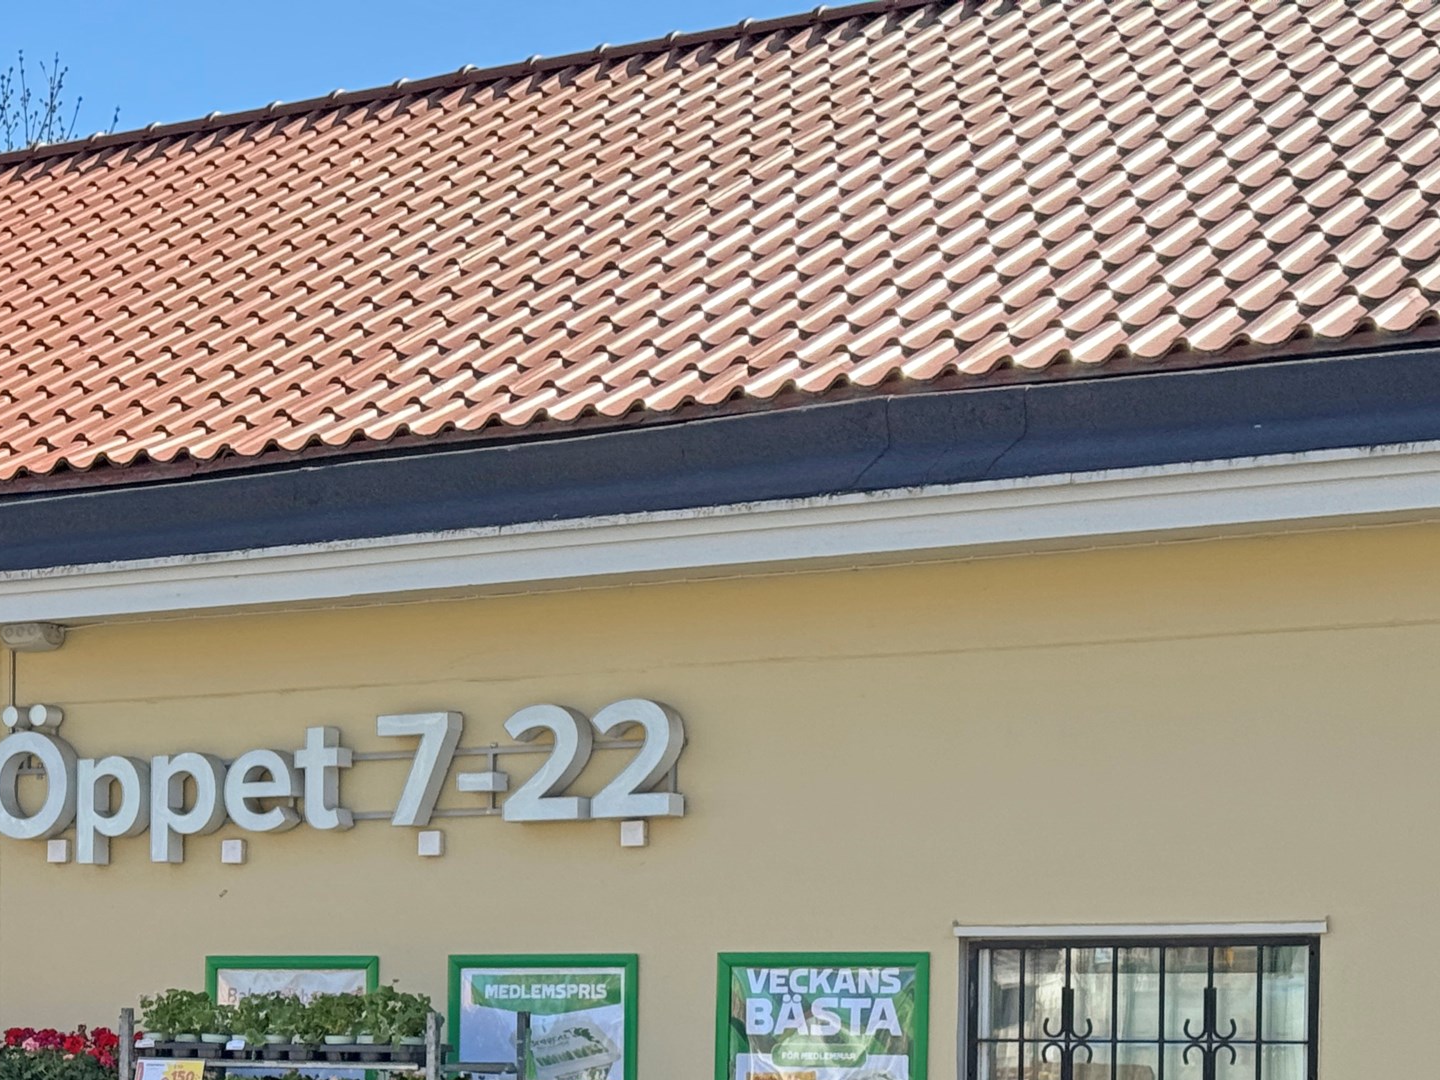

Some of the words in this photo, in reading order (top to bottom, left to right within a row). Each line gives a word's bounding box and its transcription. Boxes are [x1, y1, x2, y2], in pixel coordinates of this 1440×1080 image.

[376, 697, 687, 826] 7-22
[484, 983, 607, 999] MEDLEMSPRIS
[746, 967, 902, 994] VECKANS
[745, 994, 902, 1036] BÄSTA
